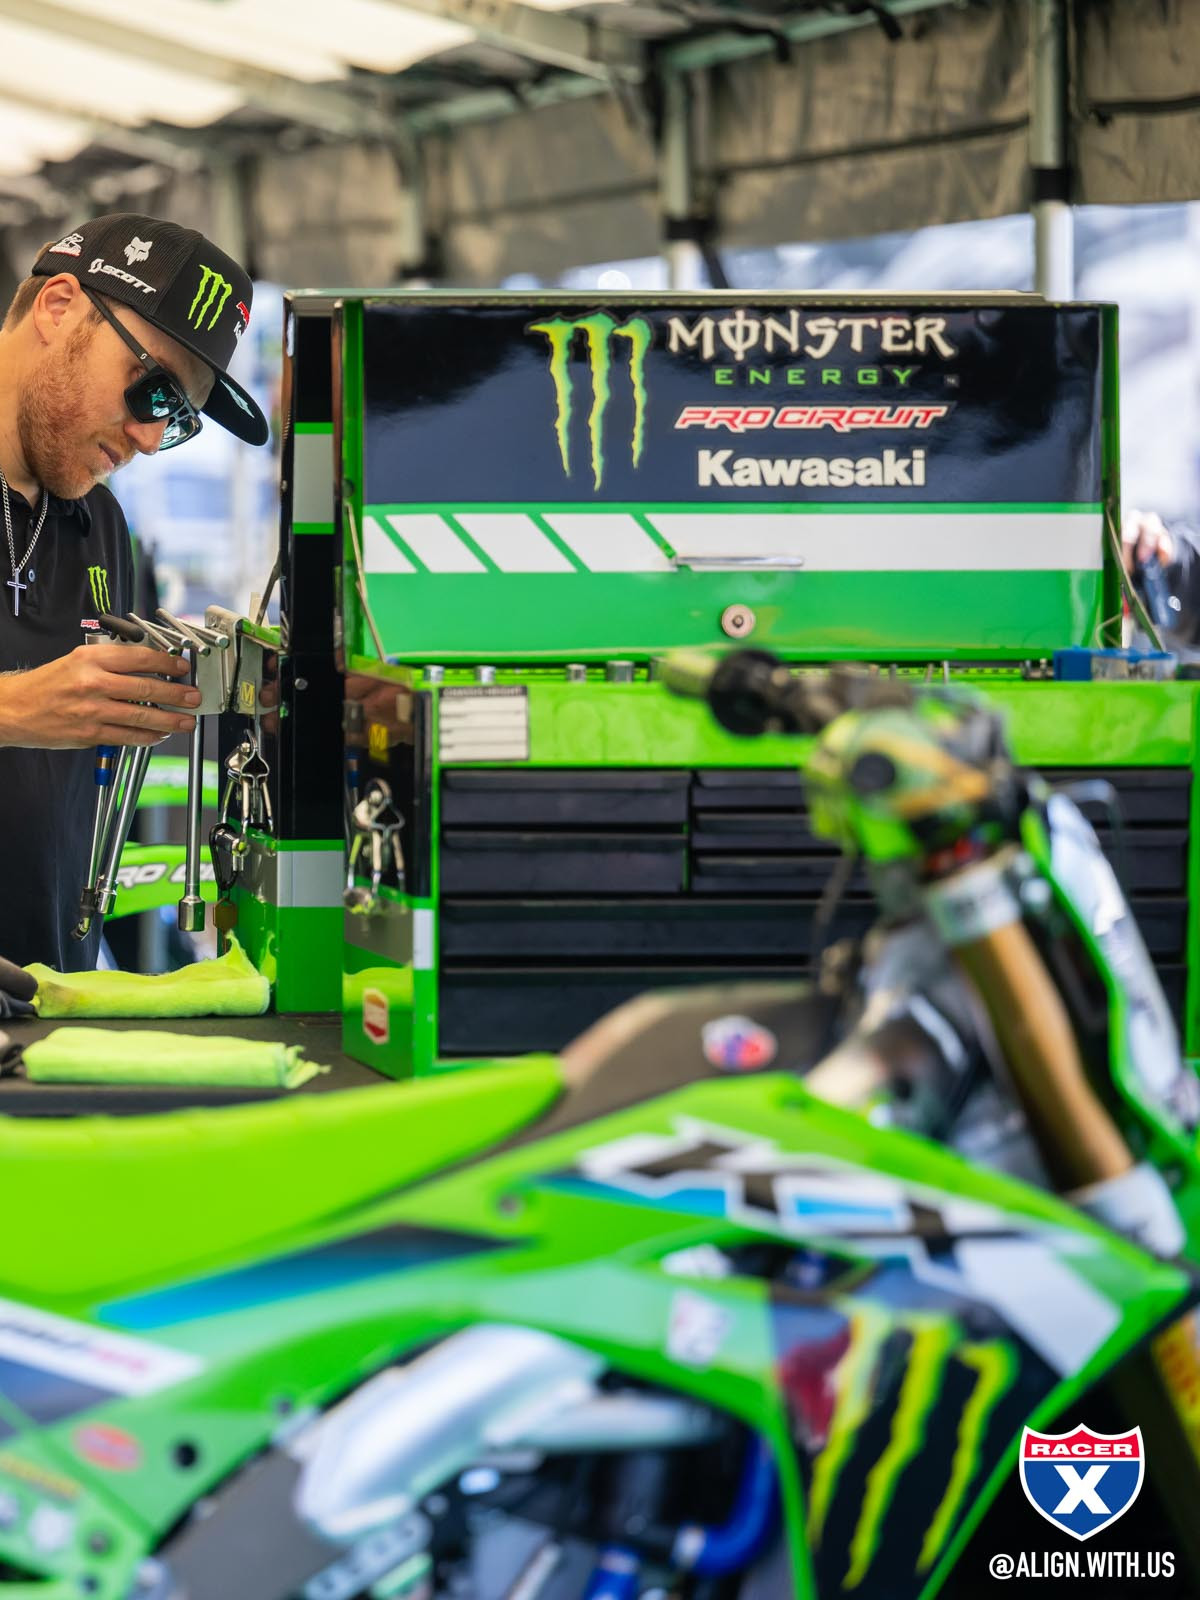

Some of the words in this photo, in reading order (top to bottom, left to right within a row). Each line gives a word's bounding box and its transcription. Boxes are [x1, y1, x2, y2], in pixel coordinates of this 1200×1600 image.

[101, 264, 157, 294] SCOTT
[667, 309, 957, 361] MONSTER
[714, 368, 912, 385] ENERGY
[675, 406, 772, 432] PRO
[773, 405, 949, 432] CIRCUIT
[698, 449, 926, 487] Kawasaki
[117, 863, 168, 889] RO
